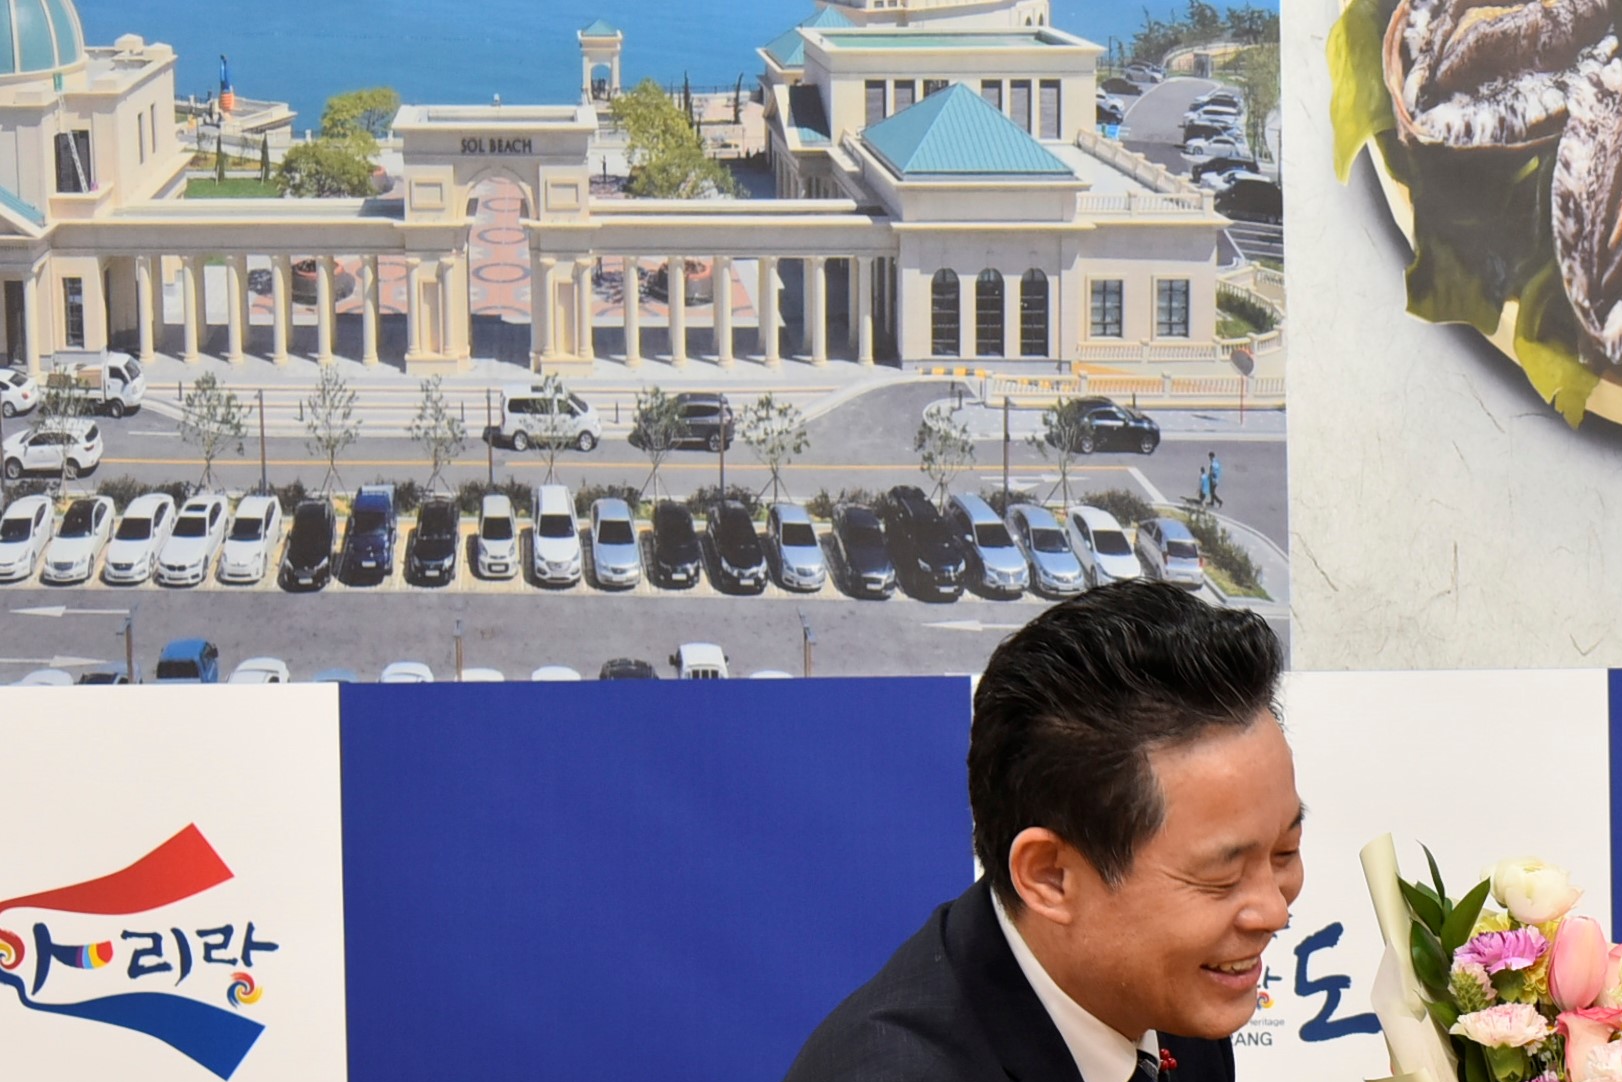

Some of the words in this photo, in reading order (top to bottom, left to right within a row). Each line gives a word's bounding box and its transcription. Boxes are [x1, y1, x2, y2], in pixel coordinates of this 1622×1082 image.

[461, 138, 485, 153] SOL
[489, 137, 532, 153] BEACH
[1251, 1018, 1285, 1027] eritage
